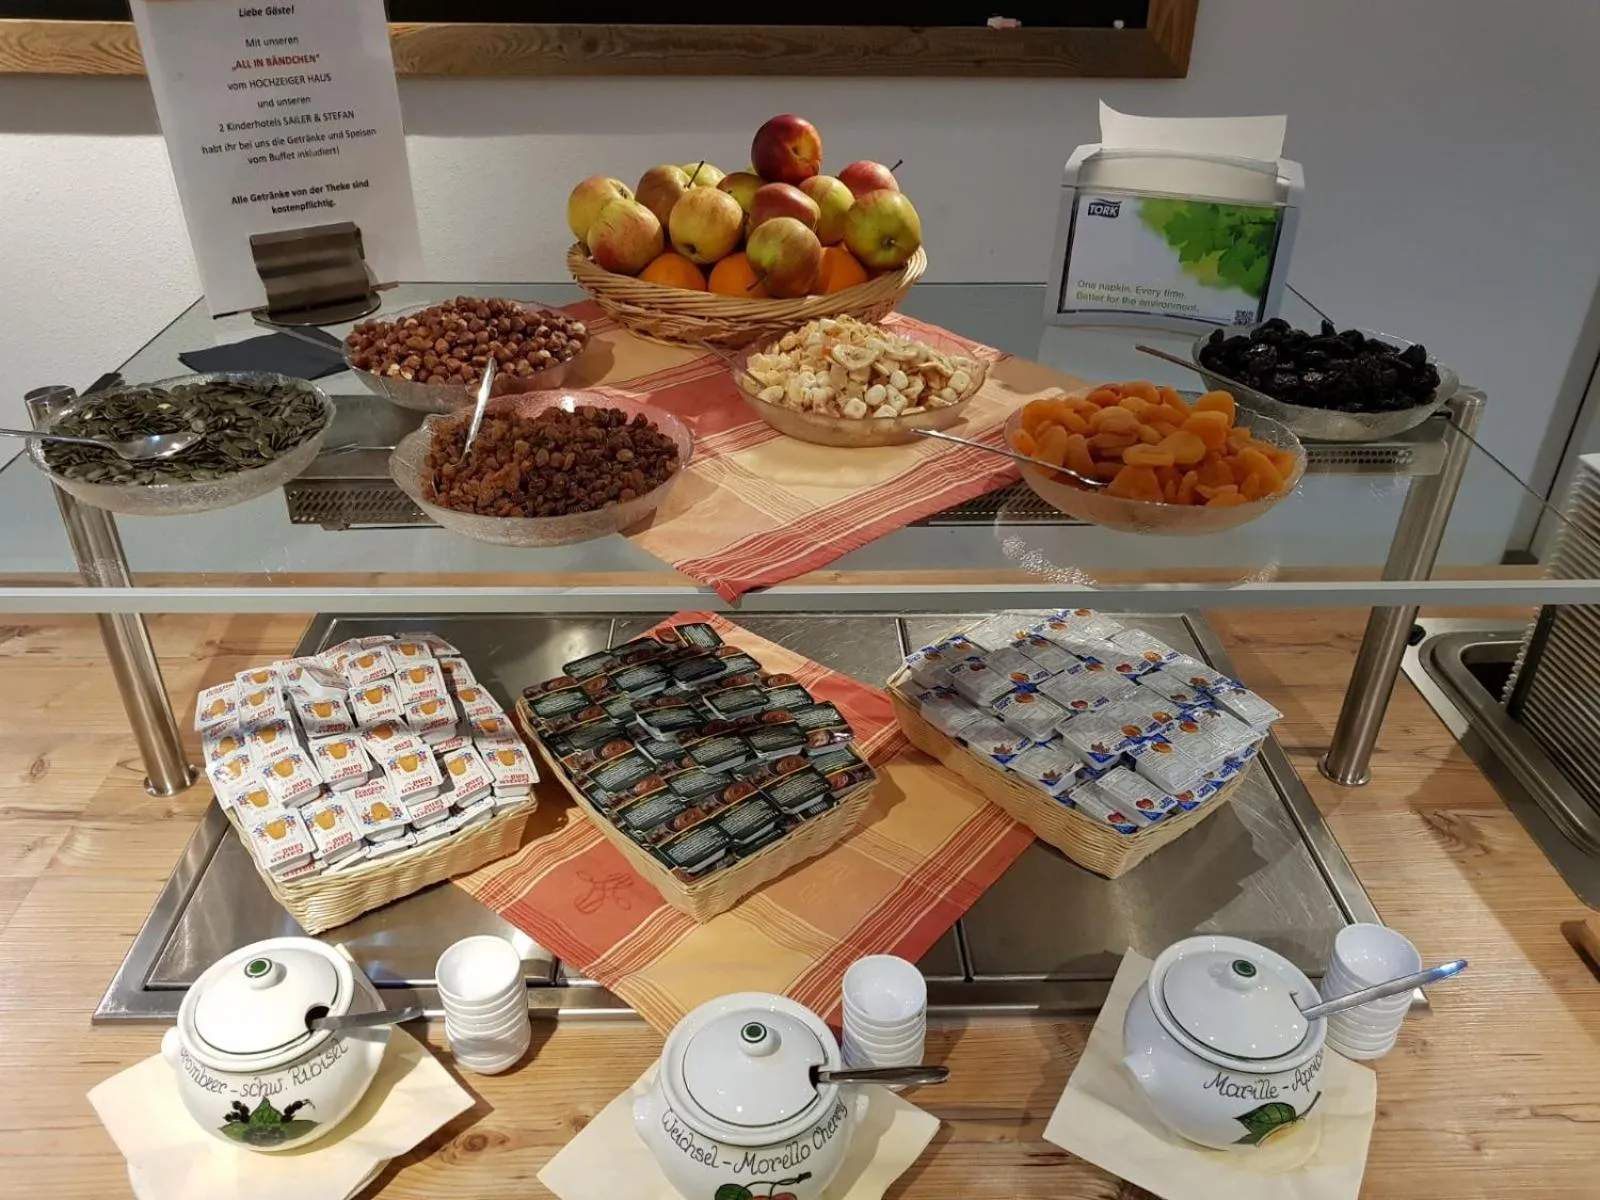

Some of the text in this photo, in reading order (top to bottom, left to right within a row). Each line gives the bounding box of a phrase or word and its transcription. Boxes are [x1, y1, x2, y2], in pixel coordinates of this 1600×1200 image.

[239, 7, 263, 18] Liebe
[245, 36, 299, 48] Mit unseren
[253, 58, 264, 68] IN
[227, 73, 332, 91] vom HOCHZEIGER HAUS
[257, 95, 311, 108] und unseren
[218, 110, 355, 132] 2 Kinderhotels SAILER & STEFAN
[201, 127, 377, 155] habt ihr bei uns die Getränke und Speisen
[247, 155, 268, 165] vom
[269, 151, 296, 163] Buffet
[231, 179, 369, 205] Alle Getränke von der Theke sind
[1089, 203, 1120, 217] TORK
[1078, 279, 1096, 290] One
[1135, 285, 1162, 299] Every
[1076, 292, 1105, 302] Better
[1106, 294, 1120, 304] for
[1121, 296, 1137, 306] the
[1203, 1071, 1280, 1099] Marille
[661, 1107, 720, 1169] Weichsel
[733, 1141, 811, 1175] Morello
[812, 1097, 849, 1151] Cherry
